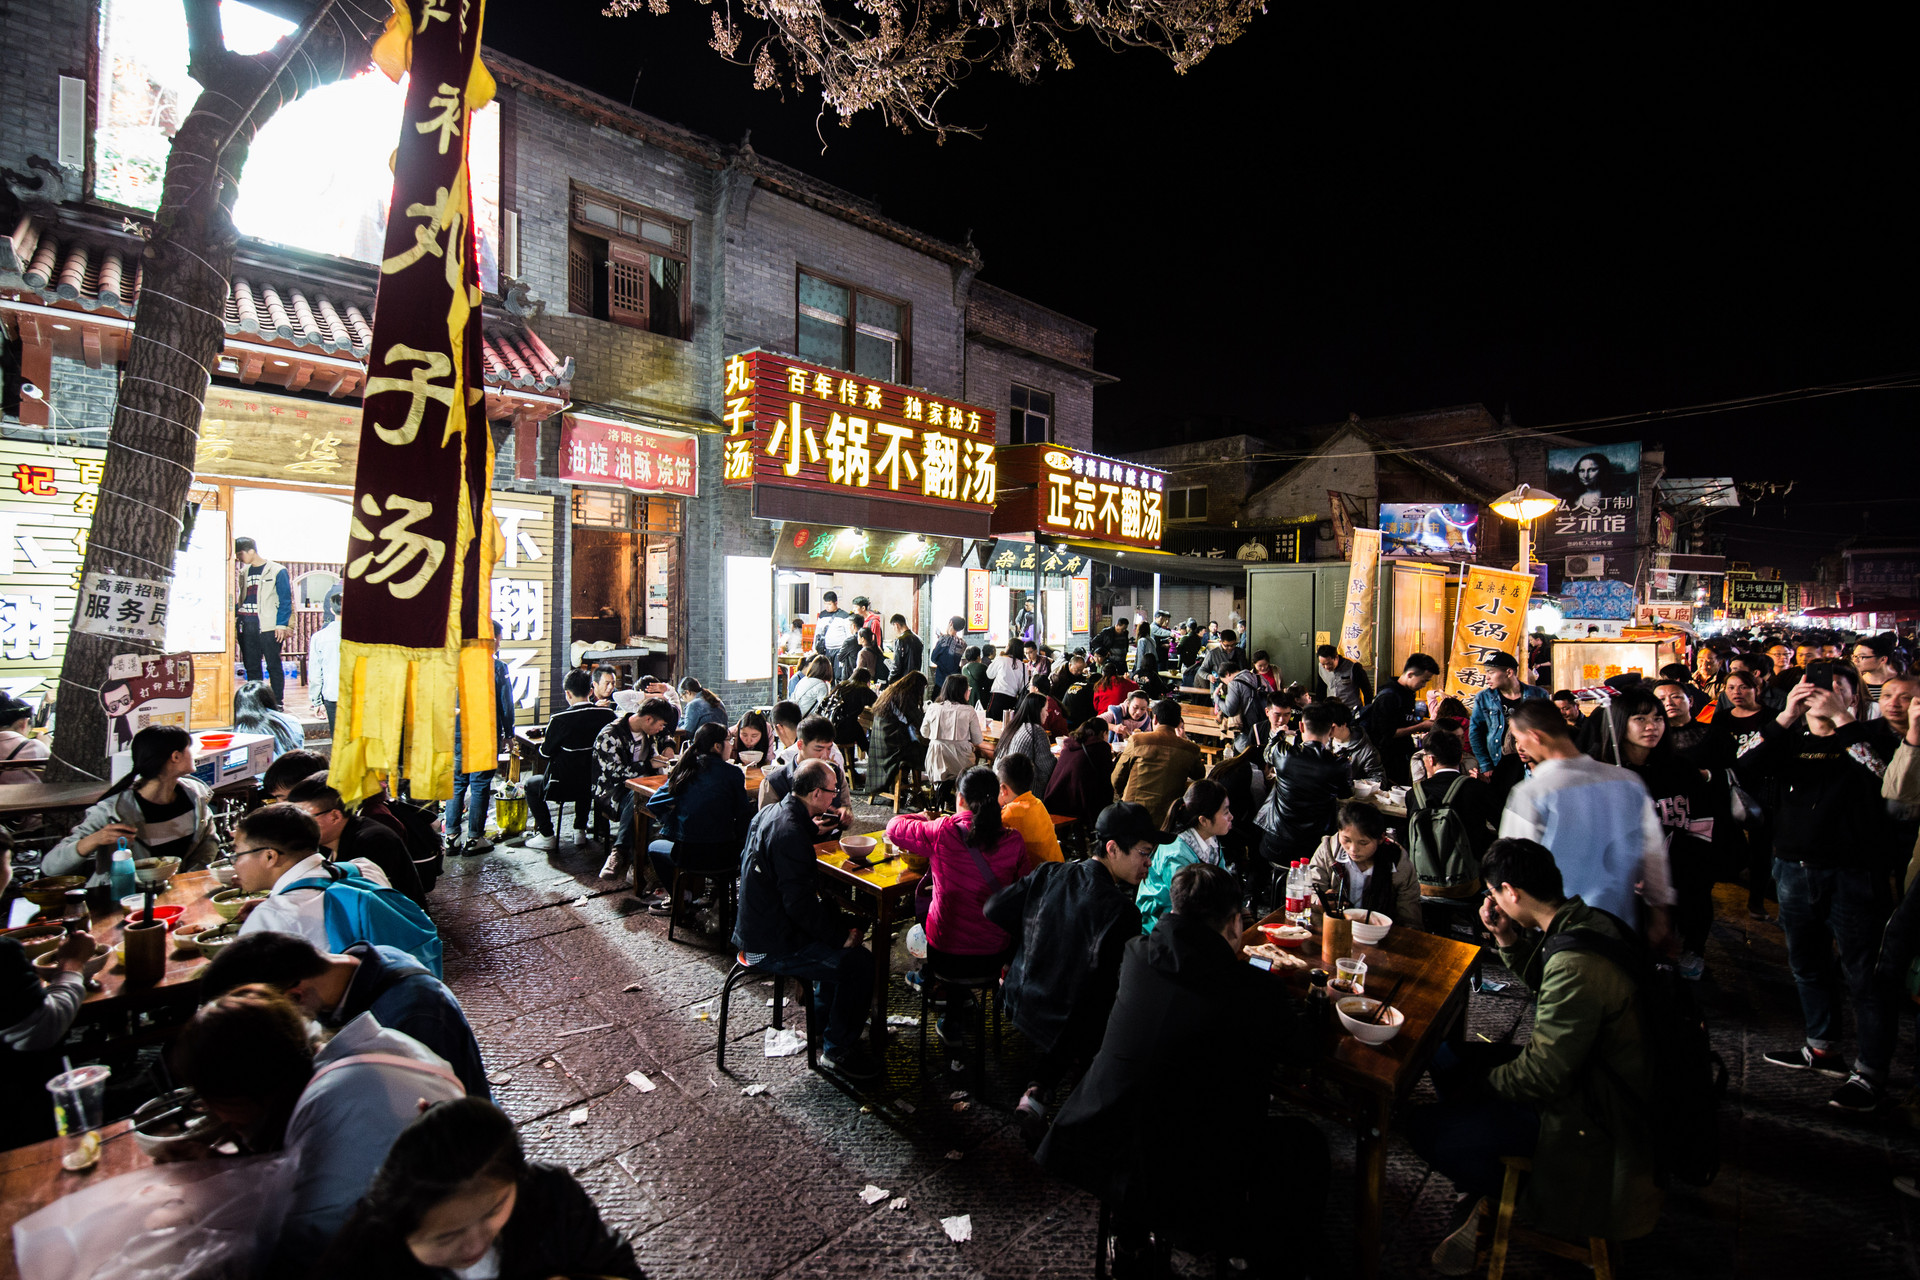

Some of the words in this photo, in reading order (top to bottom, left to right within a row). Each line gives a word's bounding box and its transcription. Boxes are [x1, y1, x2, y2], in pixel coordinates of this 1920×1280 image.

[723, 354, 755, 479] 丸子汤
[785, 367, 883, 411] 百年传承
[903, 396, 981, 434] 独家秘方
[607, 428, 658, 449] 洛阳名吃
[764, 402, 997, 505] 小锅不翻汤
[13, 464, 58, 496] 记
[567, 440, 609, 476] 油旋
[614, 446, 652, 483] 油酥
[656, 453, 692, 488] 烧饼
[1071, 455, 1163, 492] 老洛阳传统名吃
[1046, 472, 1161, 541] 正宗不翻汤
[1554, 513, 1626, 535] 艺术馆
[95, 578, 167, 601] 高薪招聘
[1473, 581, 1520, 598] 正宗老店
[85, 593, 168, 627] 服务员
[1640, 607, 1690, 620] 臭豆腐
[107, 624, 145, 636] 长期有效
